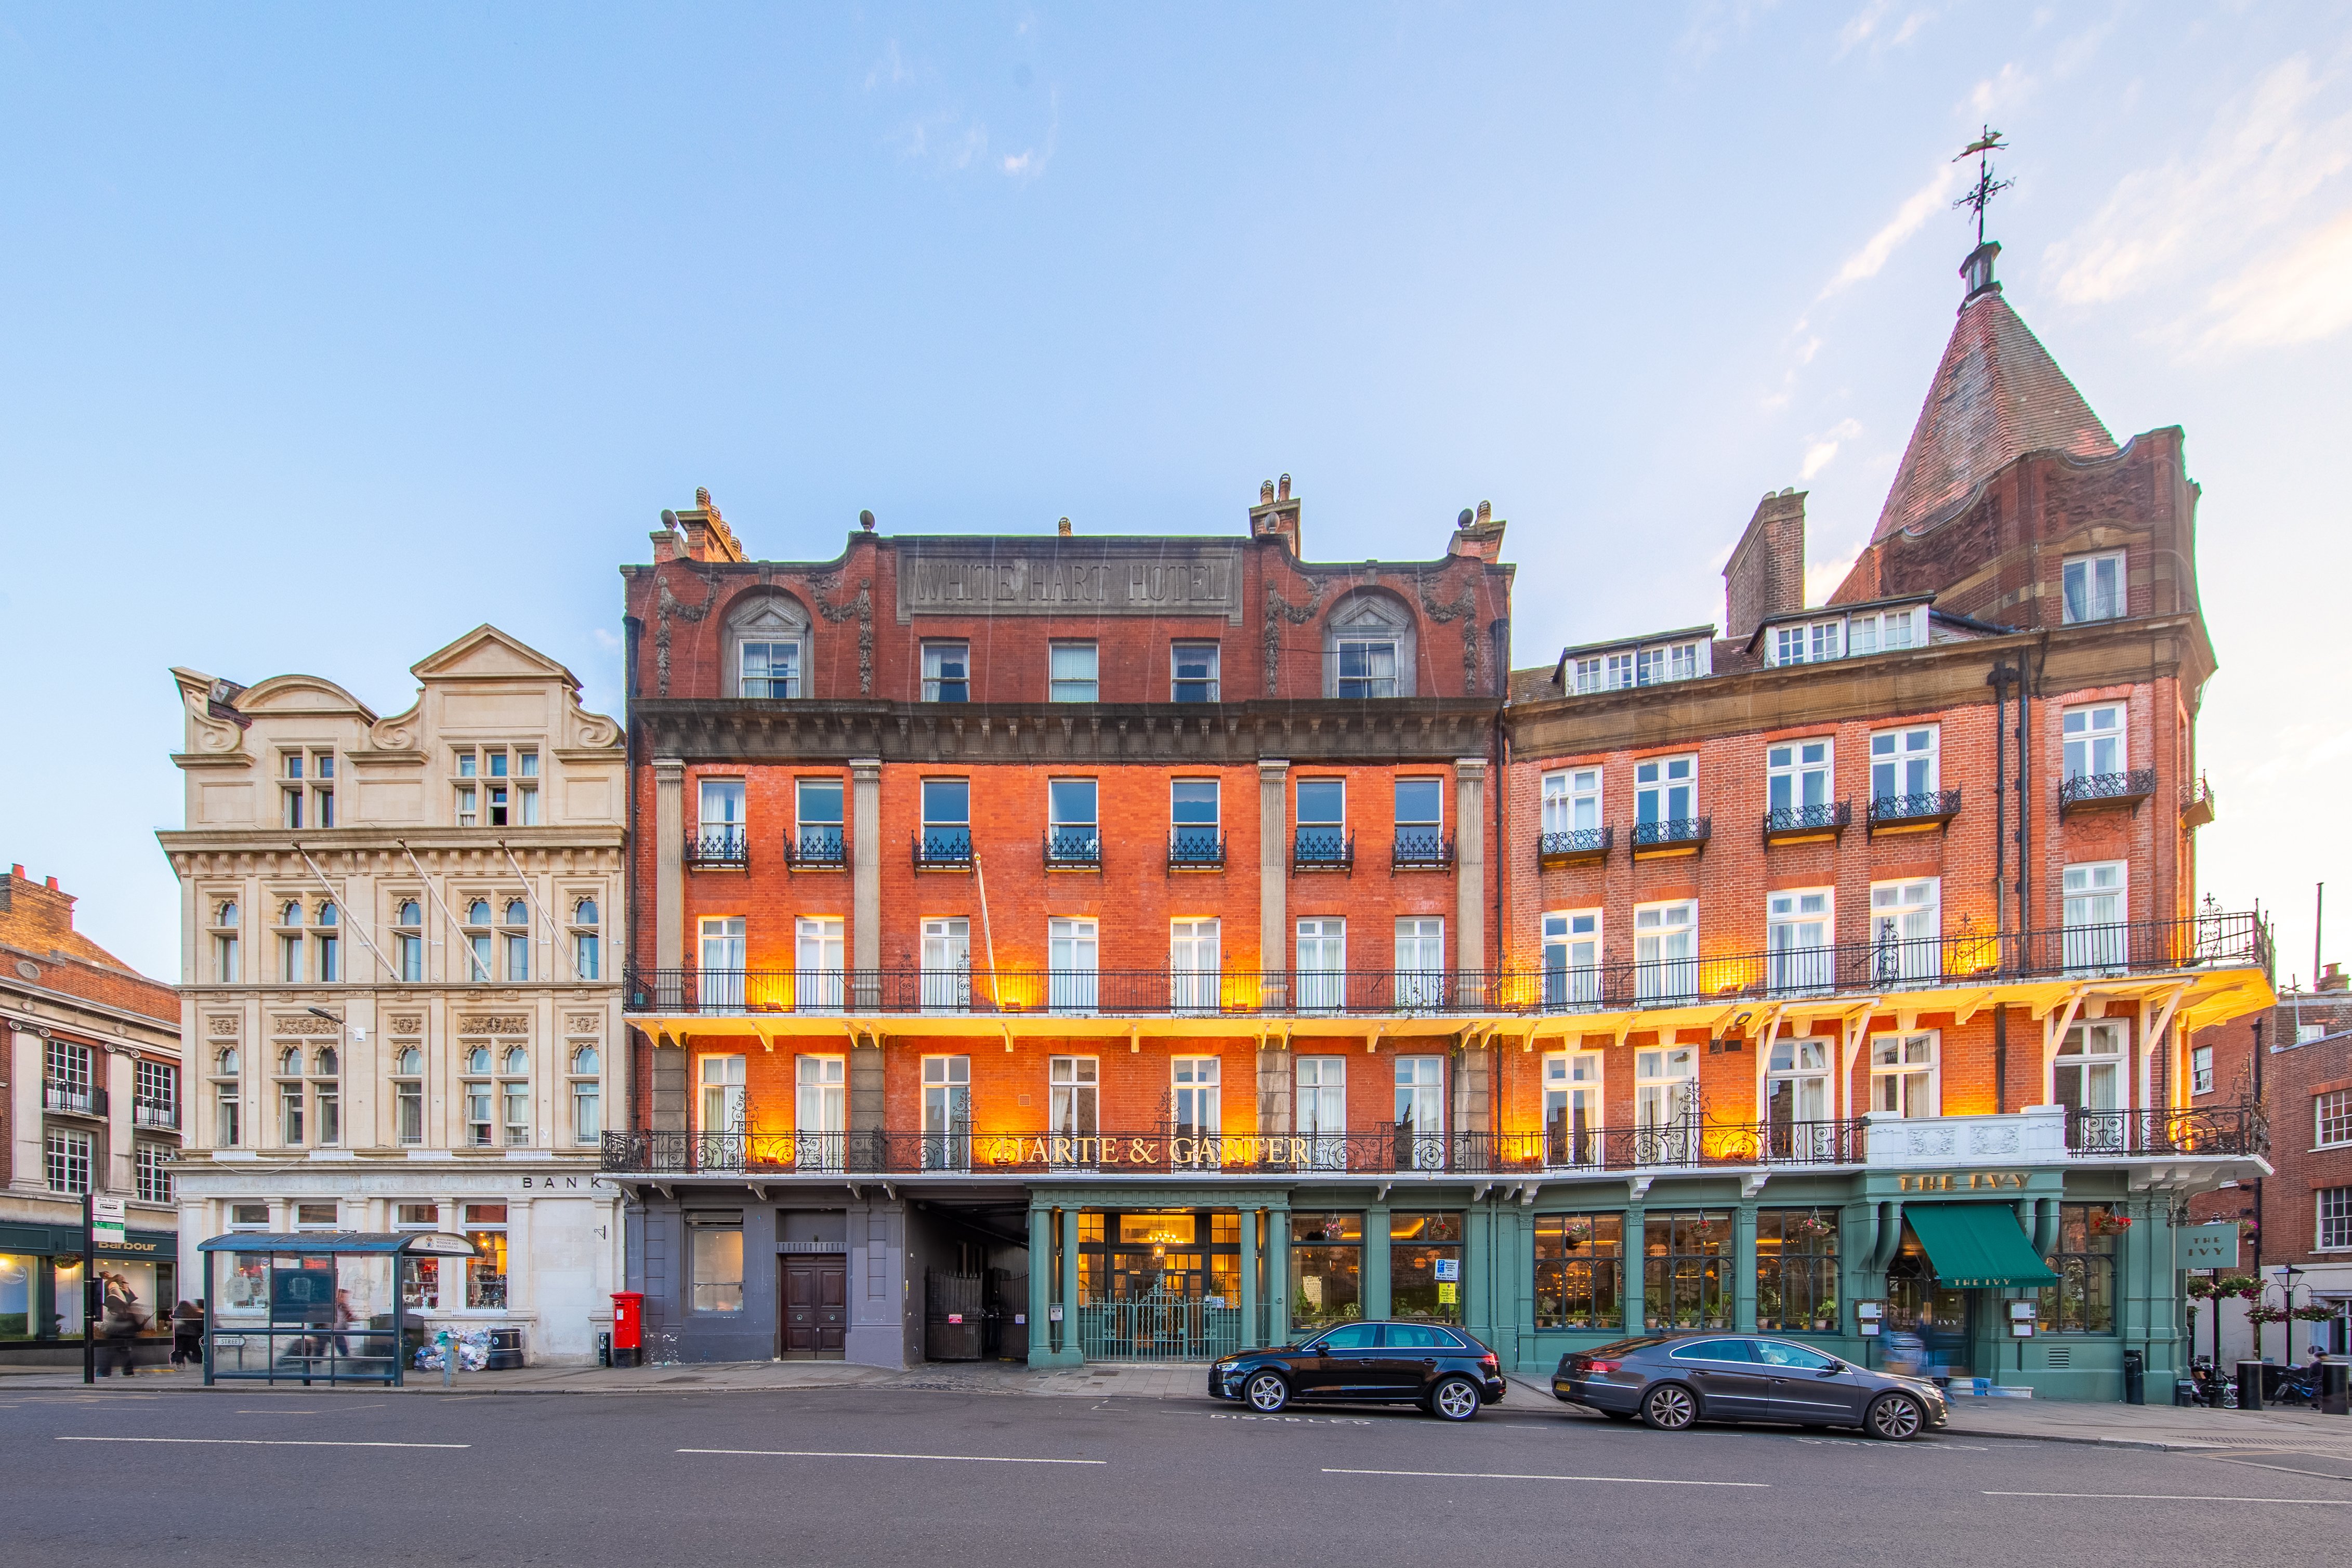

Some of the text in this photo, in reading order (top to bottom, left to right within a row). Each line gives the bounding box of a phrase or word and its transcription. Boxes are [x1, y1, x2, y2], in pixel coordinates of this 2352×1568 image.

[911, 564, 1227, 601] WHITE HART HOTEL
[997, 1137, 1311, 1164] HARTE & GARTER
[522, 1177, 602, 1188] BANK
[1901, 1174, 2033, 1191] THE IVY
[98, 1240, 156, 1251] Barbour
[2188, 1247, 2224, 1256] IVY
[1210, 1414, 1371, 1425] DISABLED
